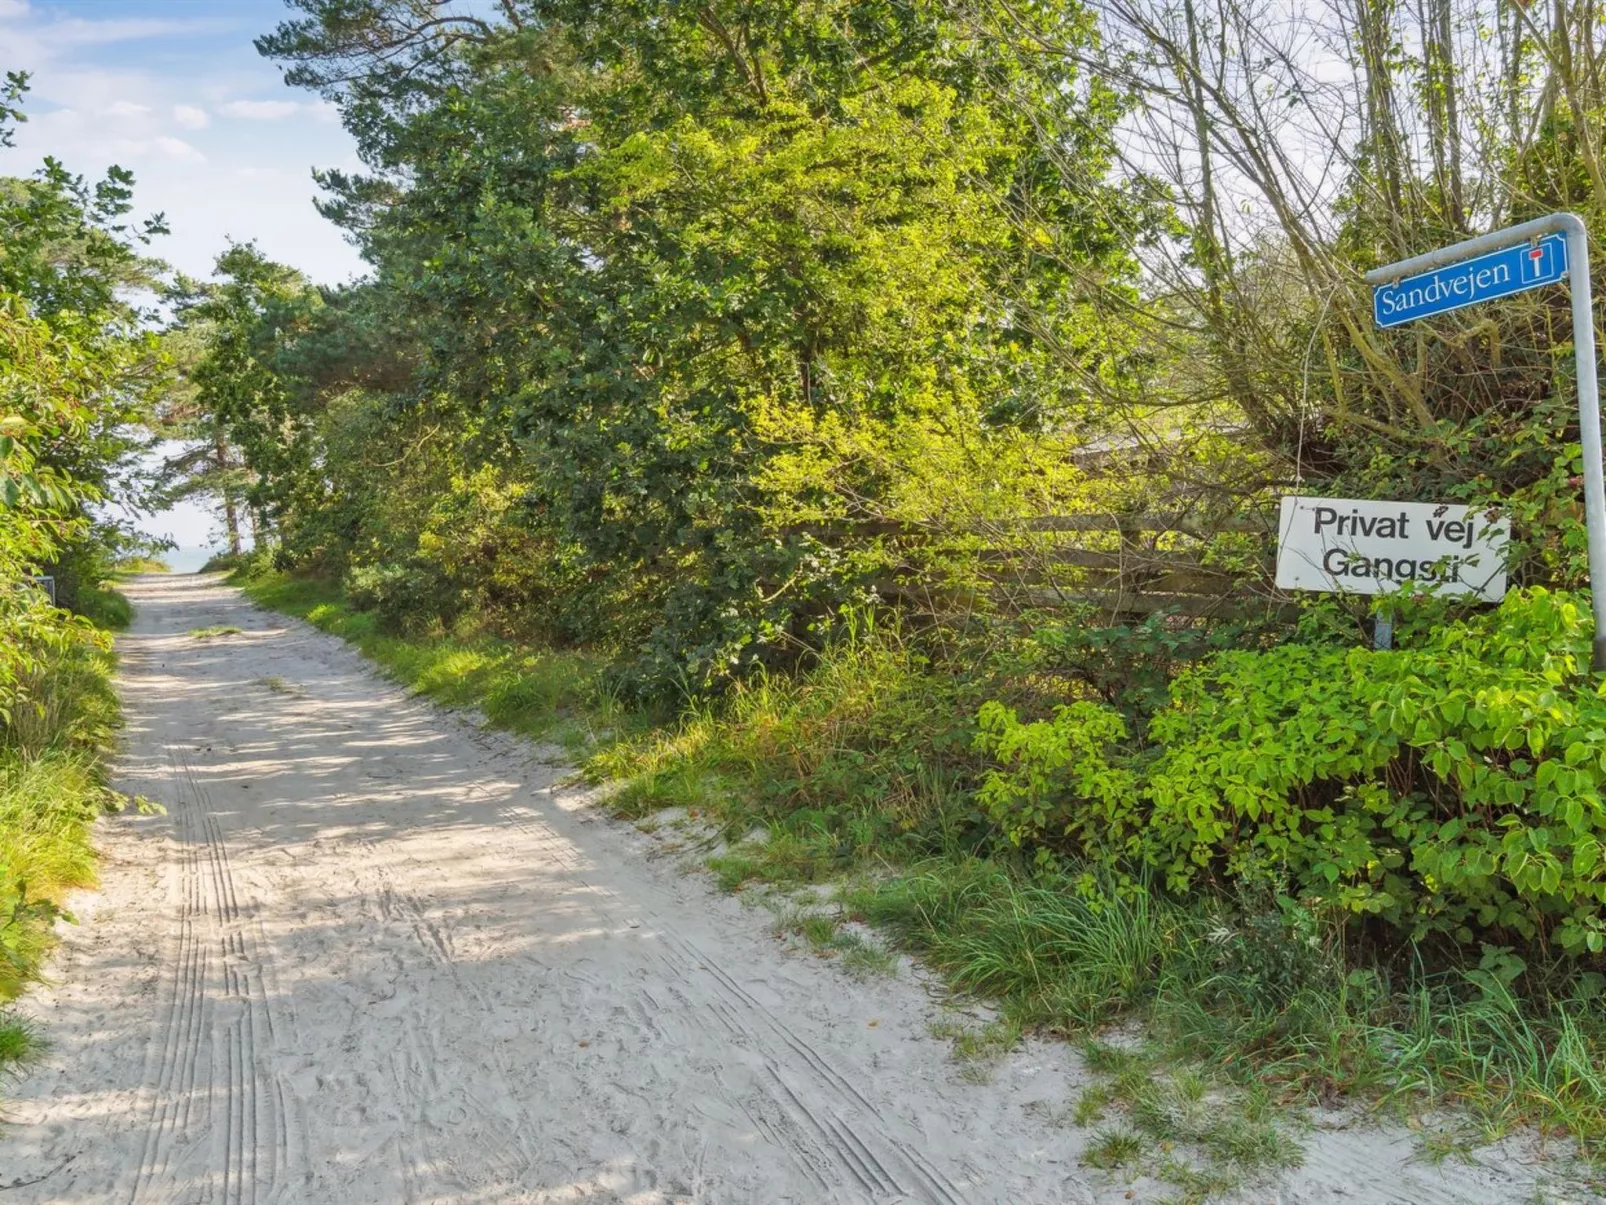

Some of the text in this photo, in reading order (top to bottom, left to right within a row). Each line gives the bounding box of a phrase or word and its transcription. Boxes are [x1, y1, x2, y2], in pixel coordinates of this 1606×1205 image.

[1382, 263, 1511, 315] Sandvejen
[1314, 506, 1474, 549] Privat vej
